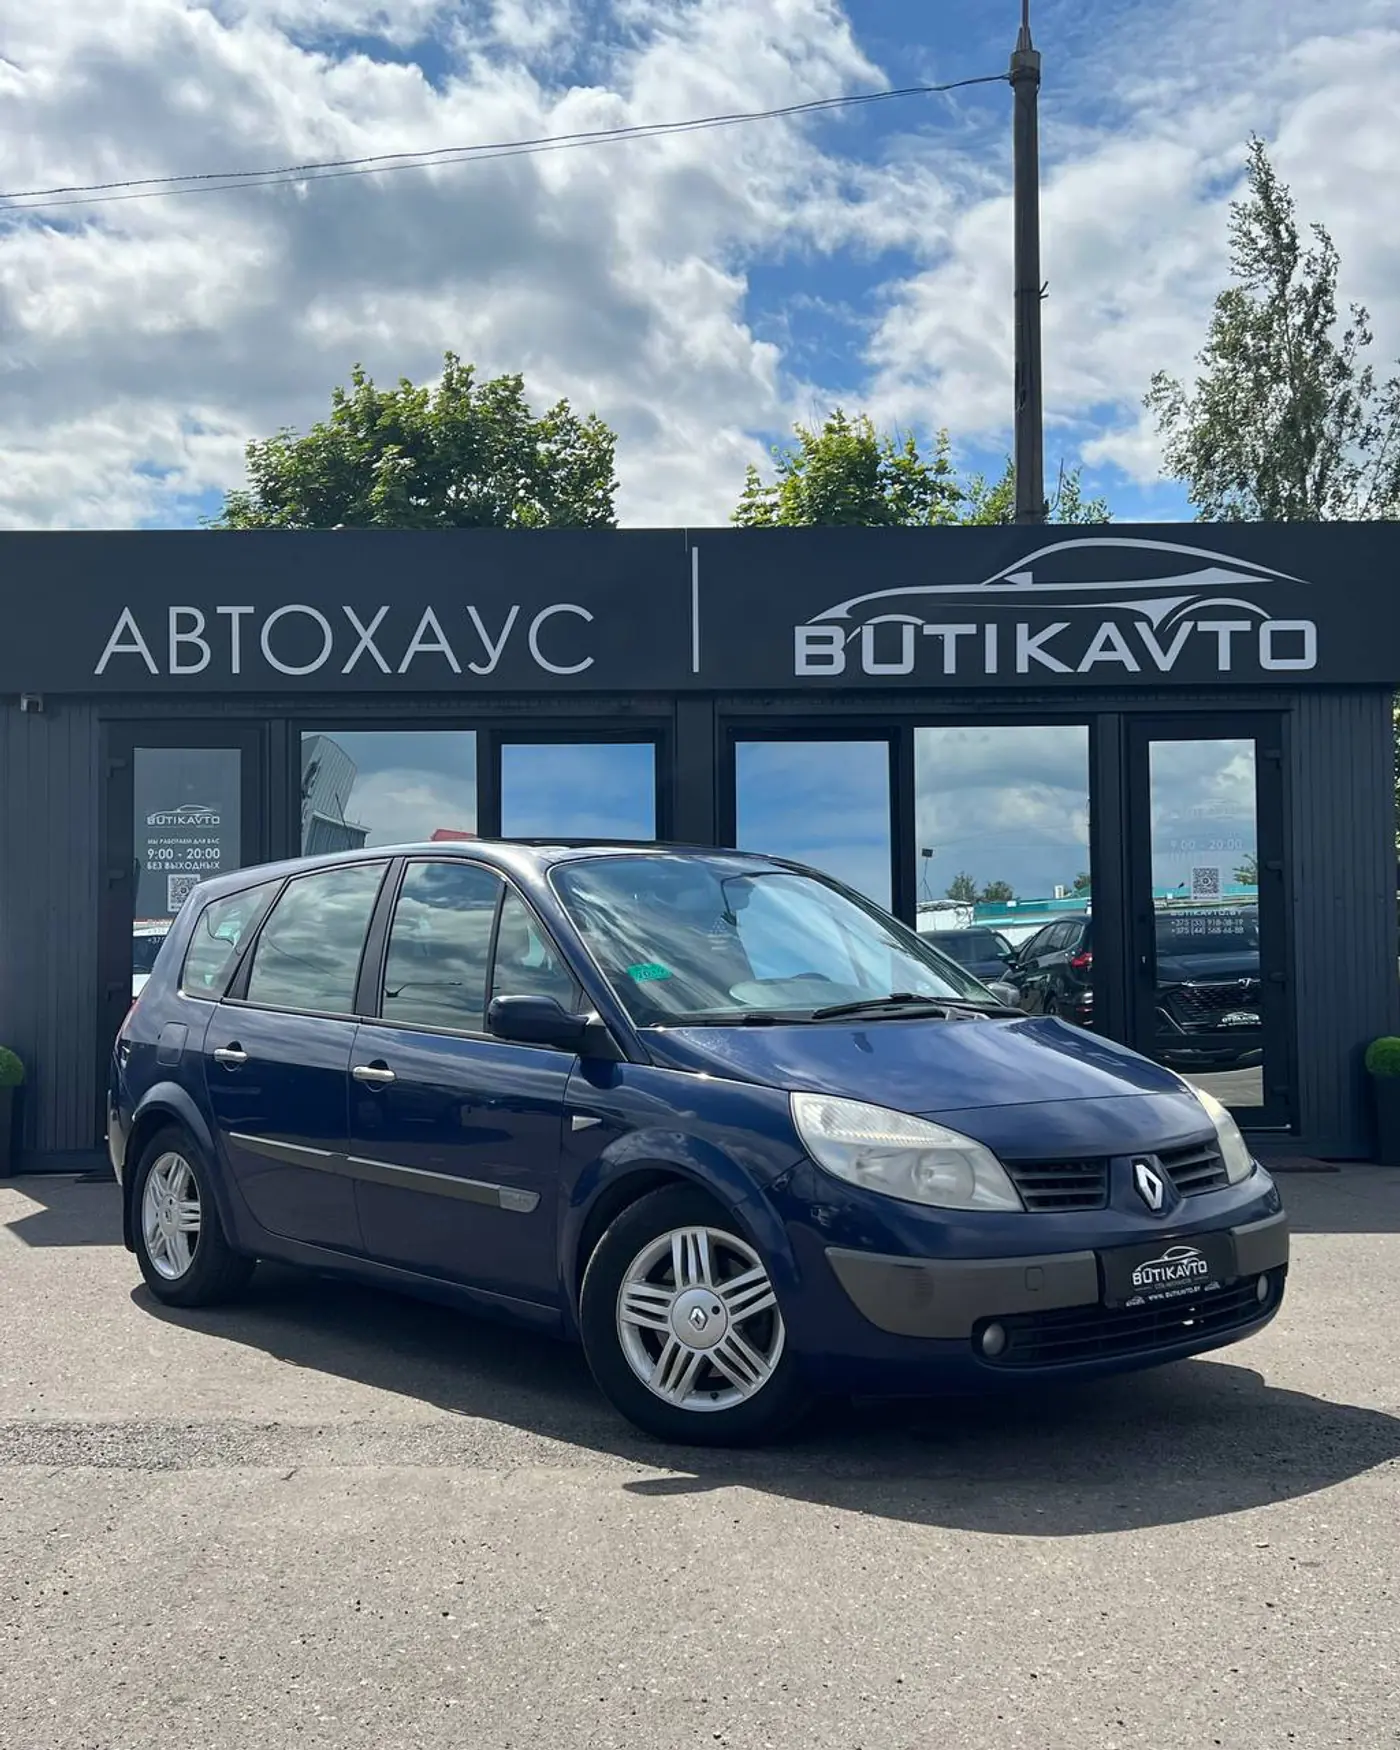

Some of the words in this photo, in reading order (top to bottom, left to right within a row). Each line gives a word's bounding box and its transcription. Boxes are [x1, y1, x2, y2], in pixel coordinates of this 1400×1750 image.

[94, 603, 595, 676] АВТОХАУС
[794, 619, 1318, 676] BUTIKAVTO
[147, 816, 220, 825] BUTIKAVTO
[147, 848, 174, 860] 9:00
[186, 848, 220, 860] 20:00
[147, 861, 163, 870] БЕЗ
[164, 861, 220, 870] ВЫХОДНЫХ
[1132, 1260, 1208, 1286] BUTIKAVTO
